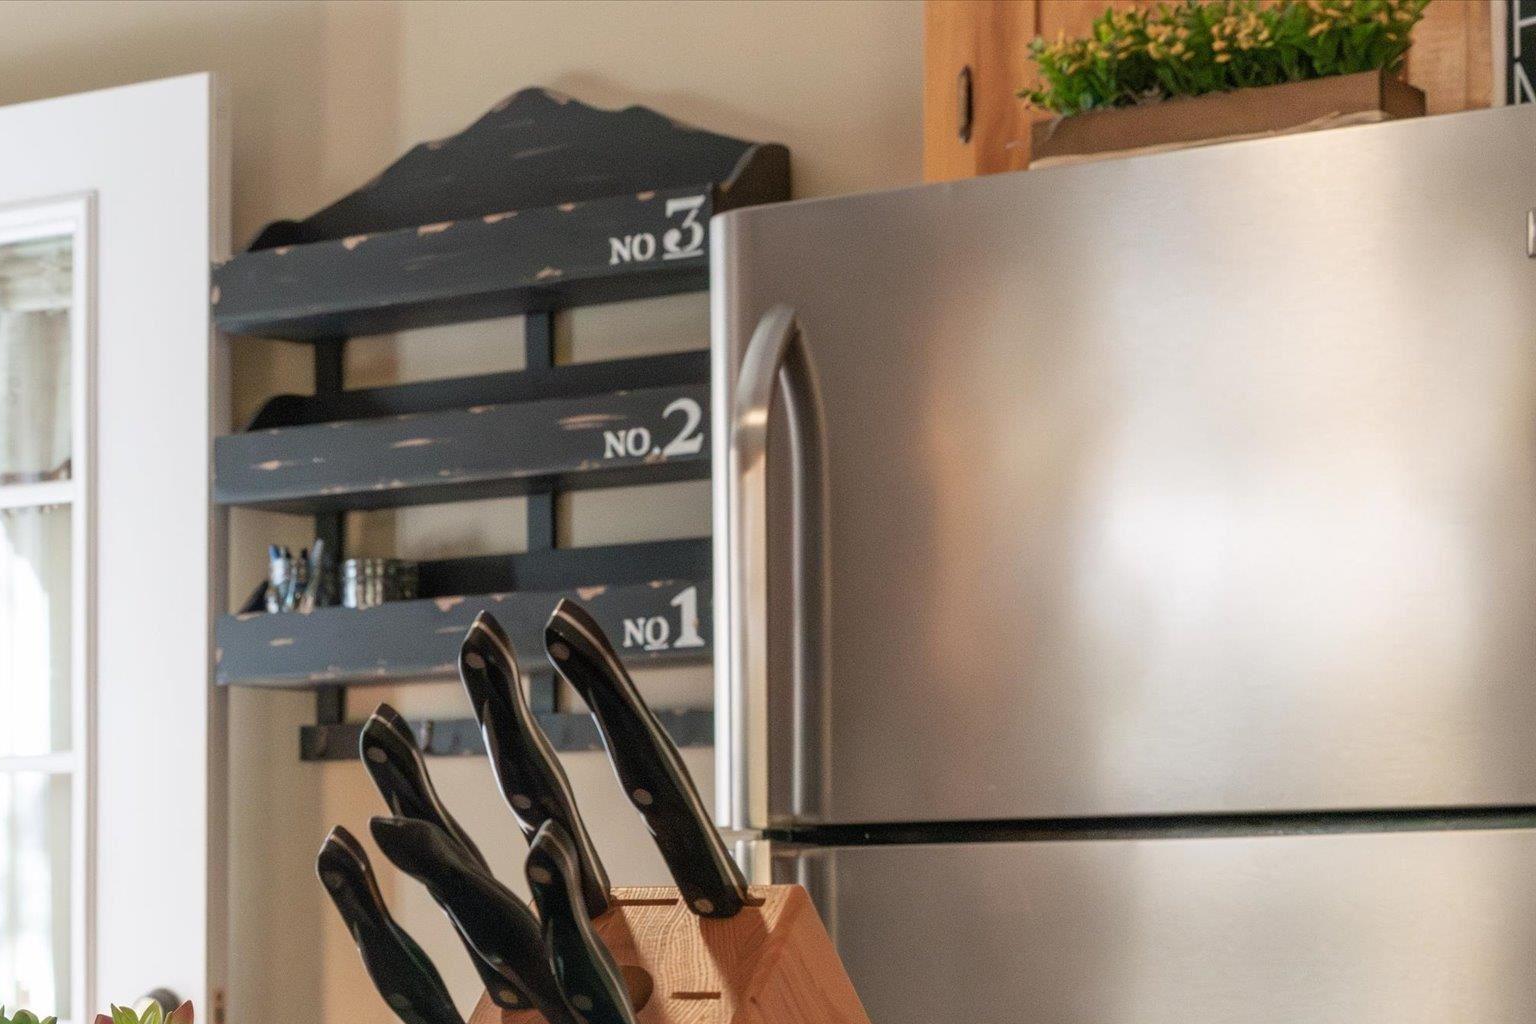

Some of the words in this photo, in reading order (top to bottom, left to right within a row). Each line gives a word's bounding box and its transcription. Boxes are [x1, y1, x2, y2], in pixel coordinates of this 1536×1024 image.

[608, 232, 656, 265] NO
[662, 194, 706, 260] 3
[662, 397, 705, 456] 2
[670, 585, 705, 648] 1
